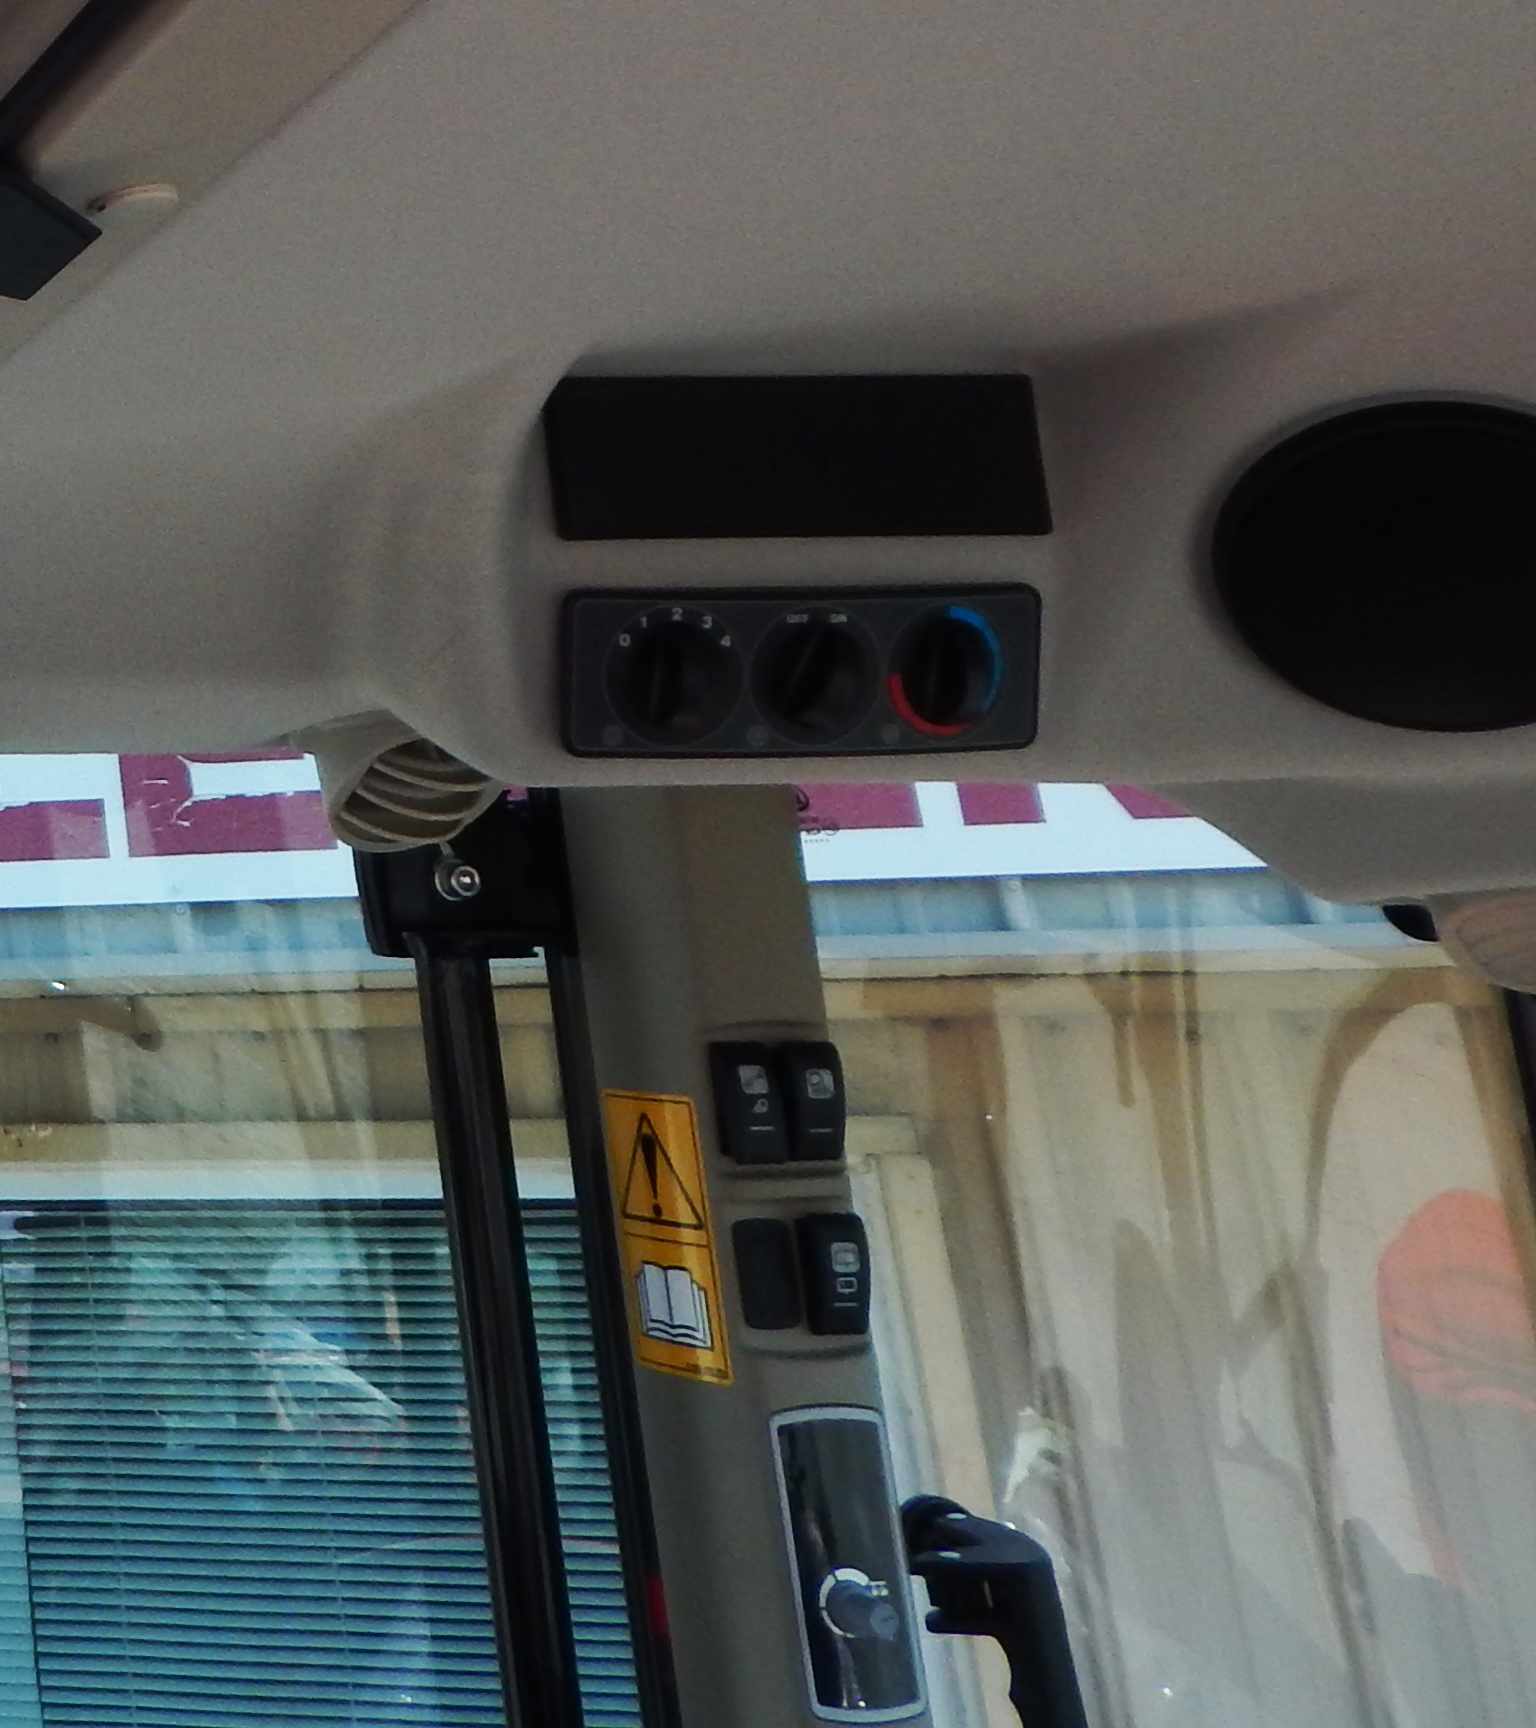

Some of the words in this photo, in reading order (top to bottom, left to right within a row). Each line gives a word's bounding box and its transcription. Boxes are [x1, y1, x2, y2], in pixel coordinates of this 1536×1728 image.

[618, 633, 631, 647] 0
[639, 616, 648, 629] 1
[671, 607, 683, 621] 2
[701, 615, 713, 629] 3
[719, 635, 731, 647] 4
